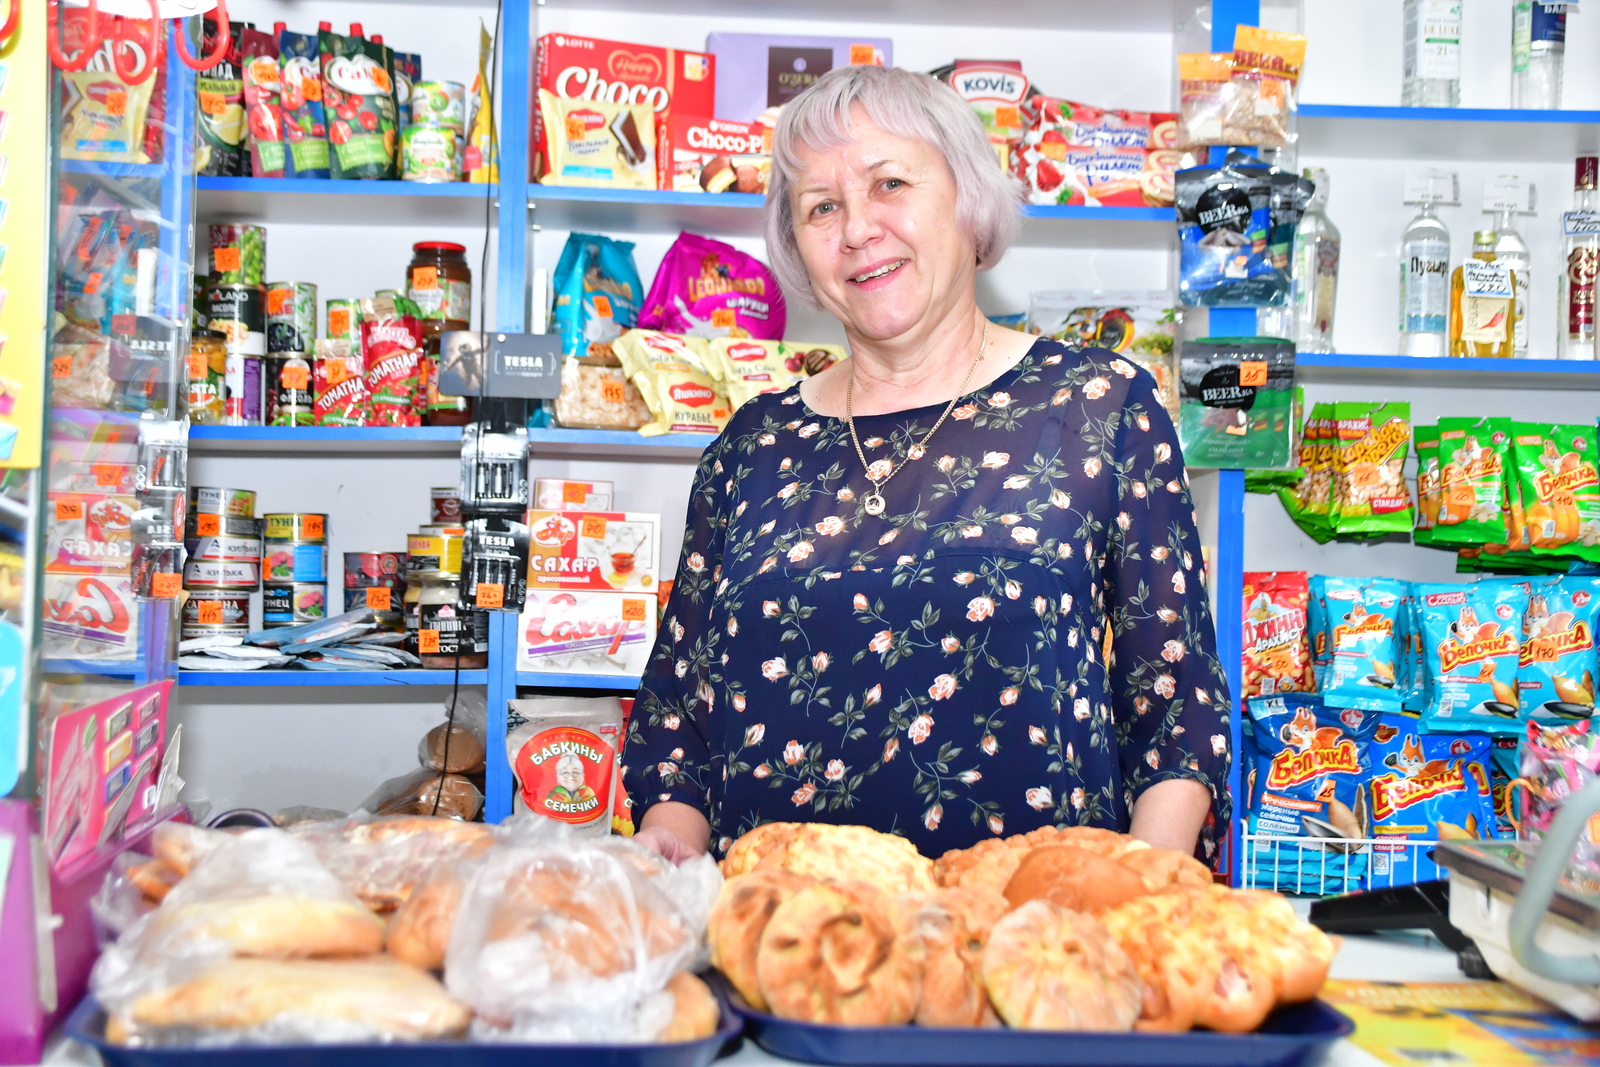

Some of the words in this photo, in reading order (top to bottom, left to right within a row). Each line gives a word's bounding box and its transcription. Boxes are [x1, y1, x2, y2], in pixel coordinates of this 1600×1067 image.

[565, 38, 595, 50] LOTTE
[555, 65, 670, 113] Choco
[504, 355, 544, 368] TESLA
[318, 377, 365, 411] ТОМАТНА
[673, 388, 712, 401] Яшкино
[1338, 419, 1369, 431] АРАХИС
[479, 534, 515, 547] TESLA
[186, 600, 239, 610] САНА
[1266, 697, 1283, 708] XL
[529, 741, 604, 766] БАБКИНЫ
[544, 797, 600, 813] СЕМЕЧКИ
